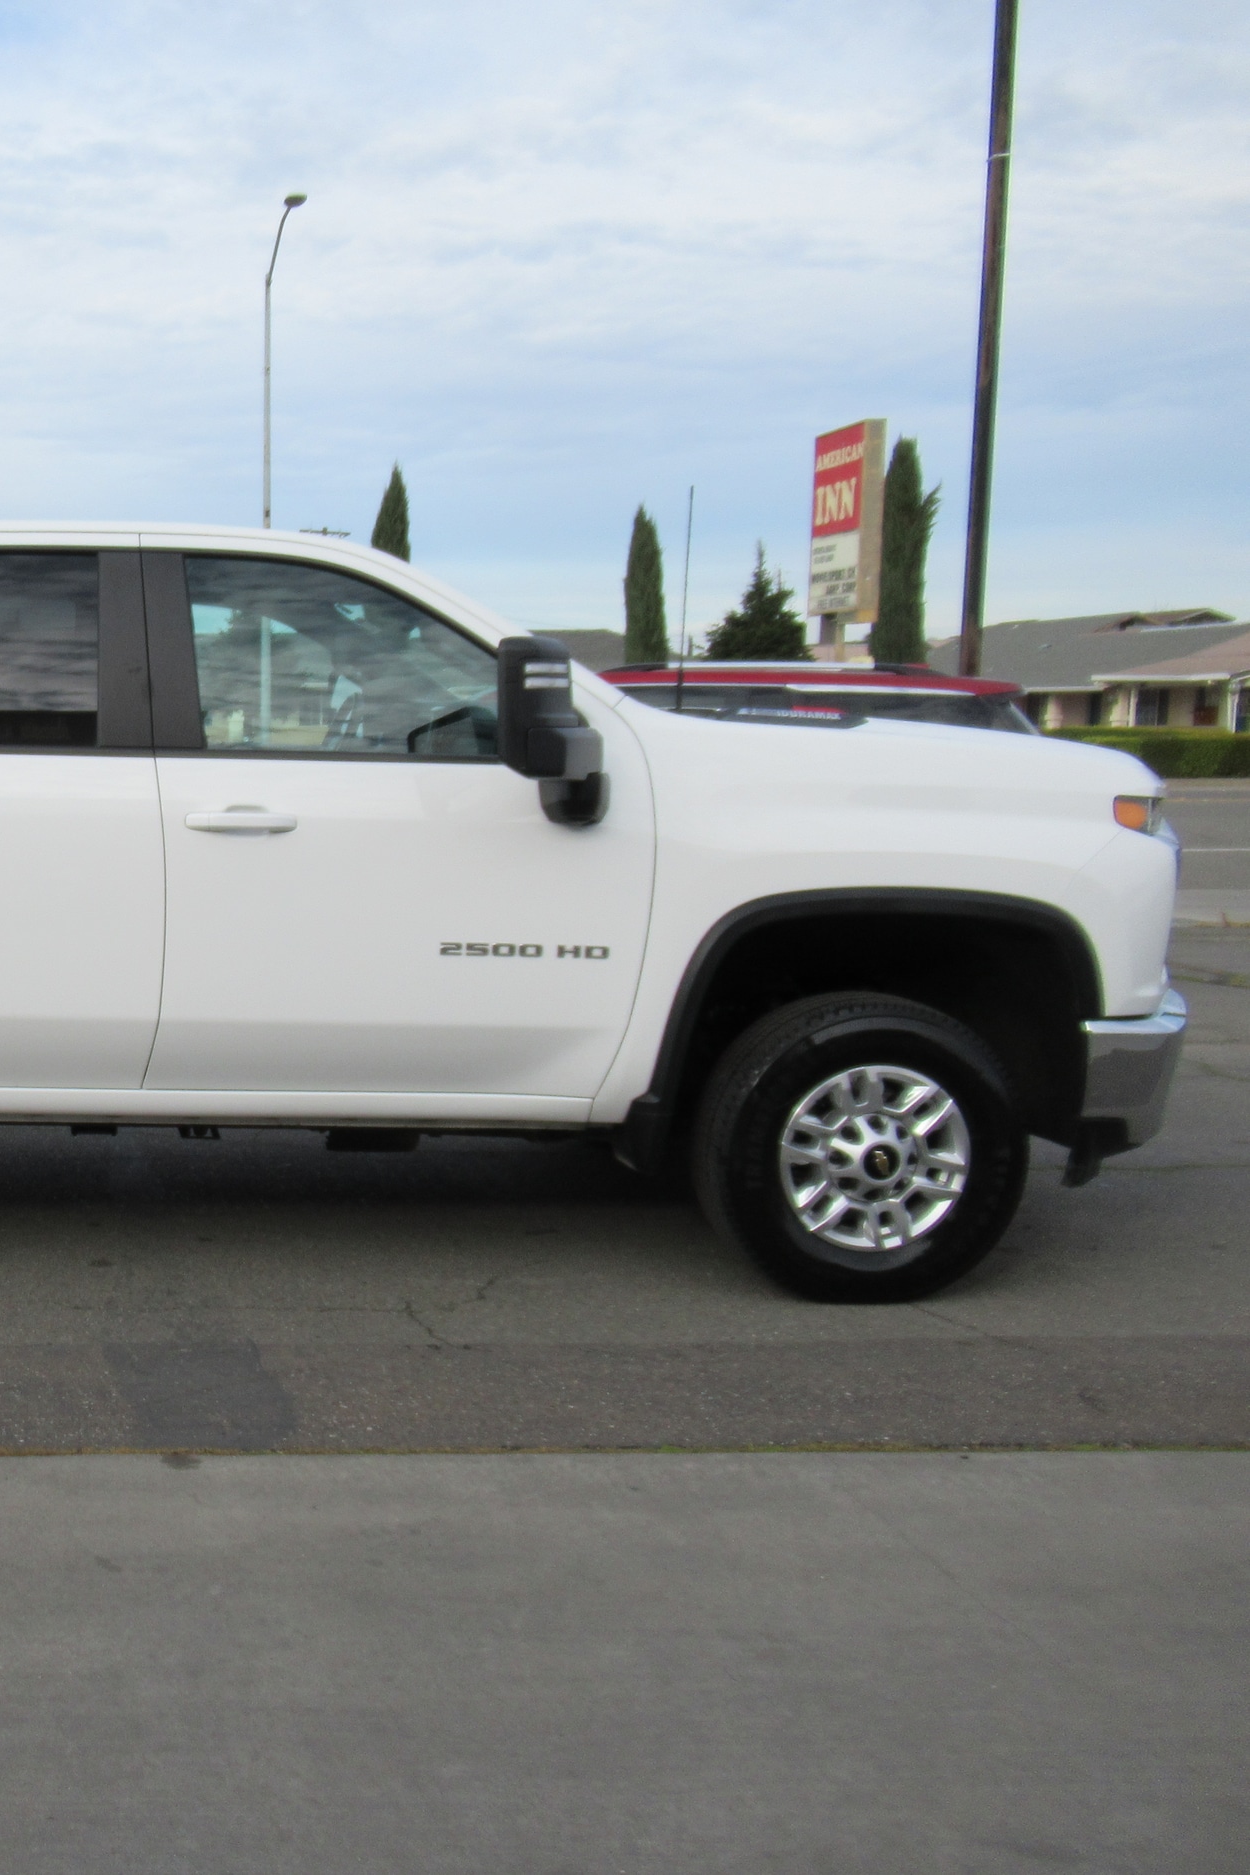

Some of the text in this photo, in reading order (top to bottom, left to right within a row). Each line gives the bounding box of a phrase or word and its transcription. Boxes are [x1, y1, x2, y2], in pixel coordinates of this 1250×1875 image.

[816, 441, 865, 472] AMERICAN
[815, 477, 857, 526] INN
[440, 942, 610, 959] 2500 HD
